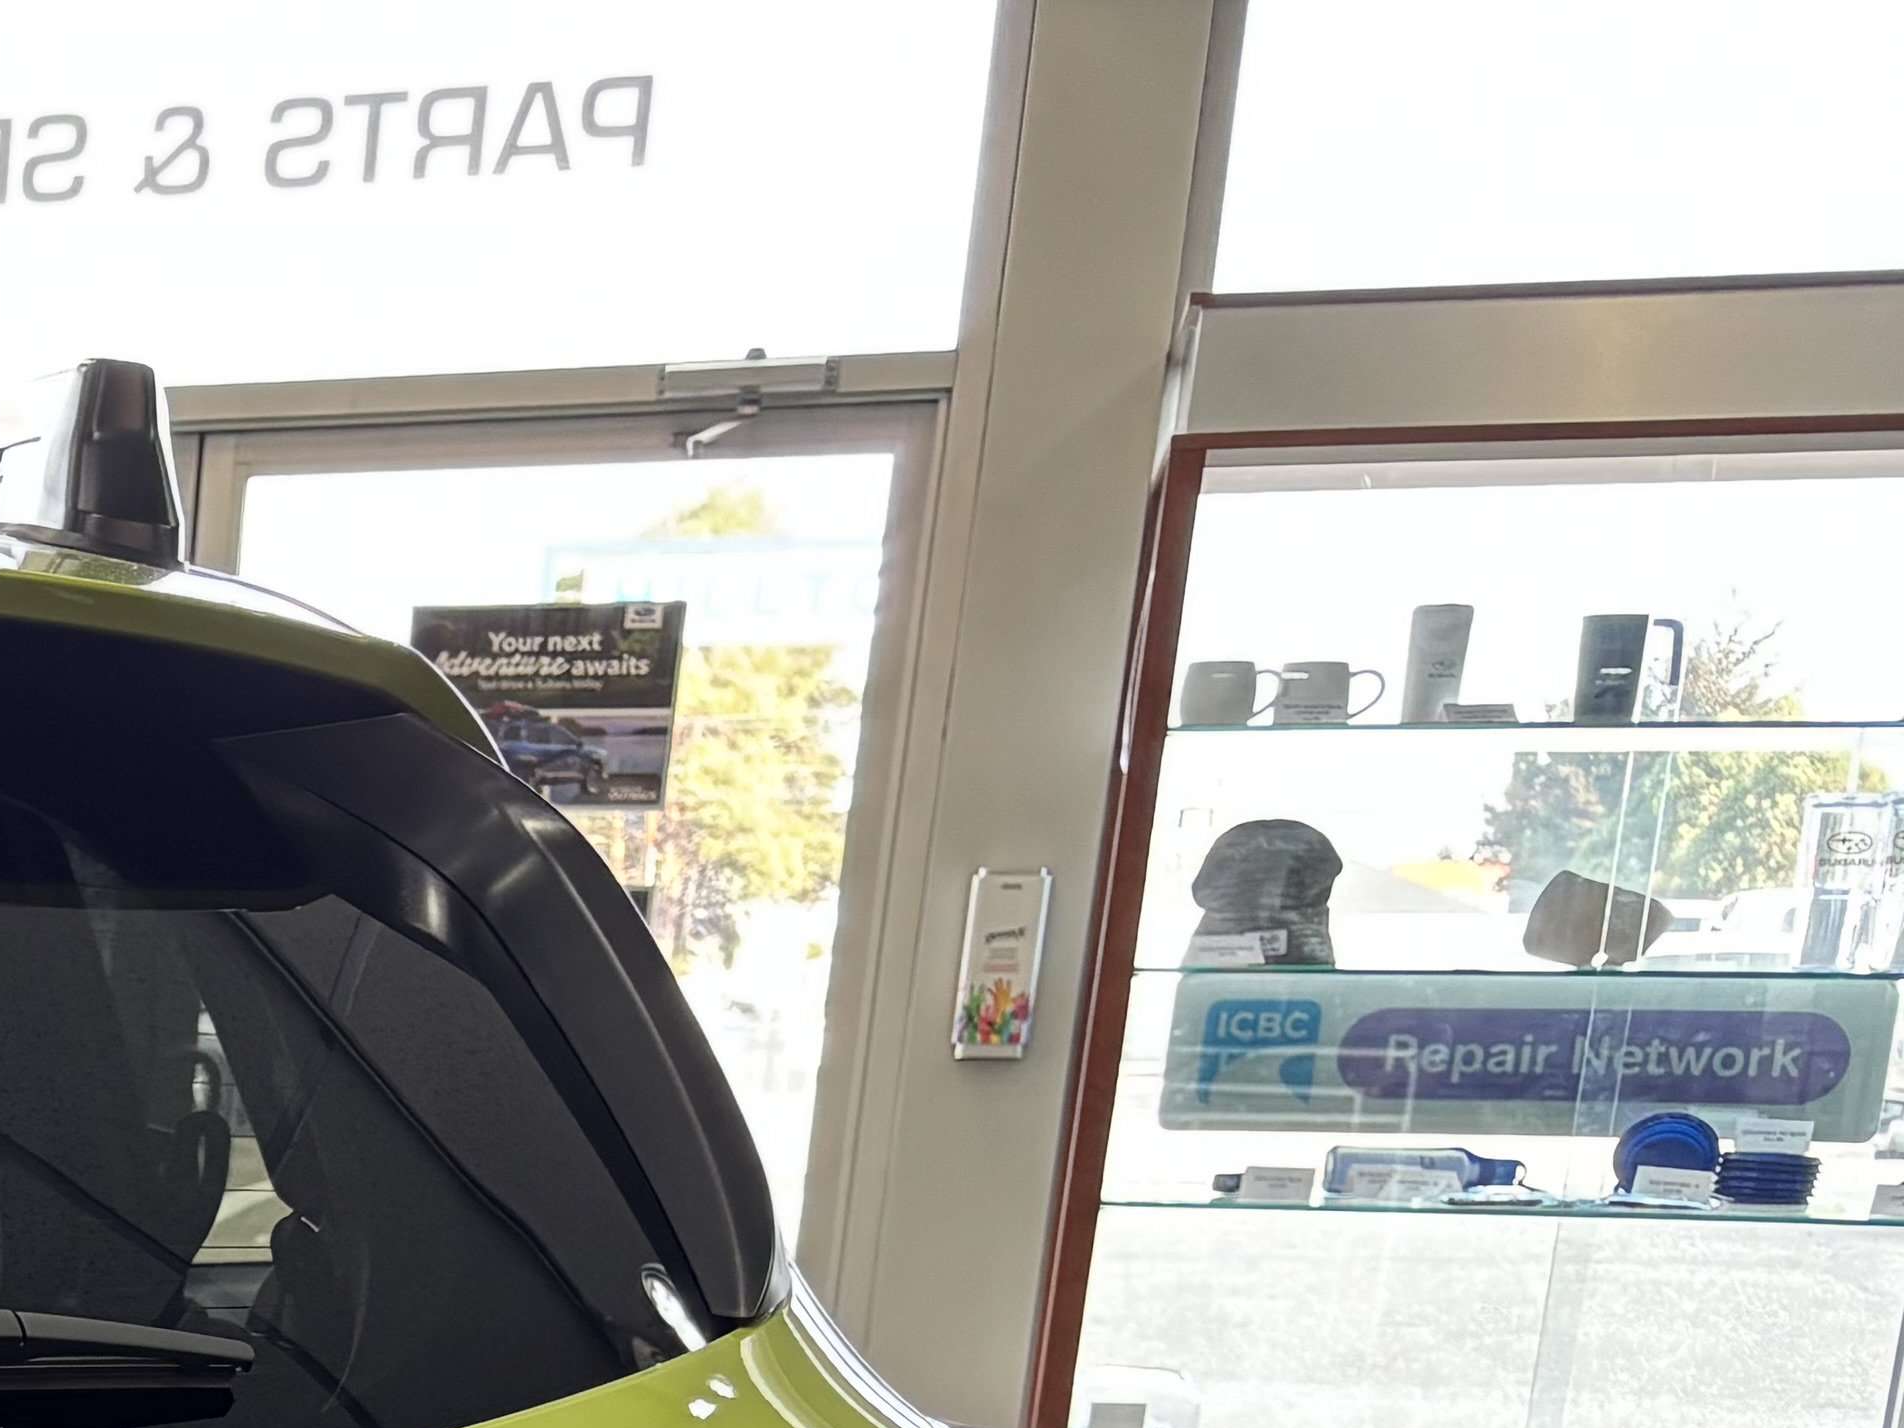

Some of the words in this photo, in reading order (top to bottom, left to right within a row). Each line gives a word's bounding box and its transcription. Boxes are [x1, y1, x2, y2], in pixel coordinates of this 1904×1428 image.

[488, 631, 544, 653] Your
[547, 631, 603, 651] next
[435, 651, 570, 677] Adventure
[571, 653, 651, 676] awaits
[1215, 1011, 1310, 1039] ICBC
[1385, 1034, 1558, 1082] Repair
[1570, 1034, 1801, 1079] Network
